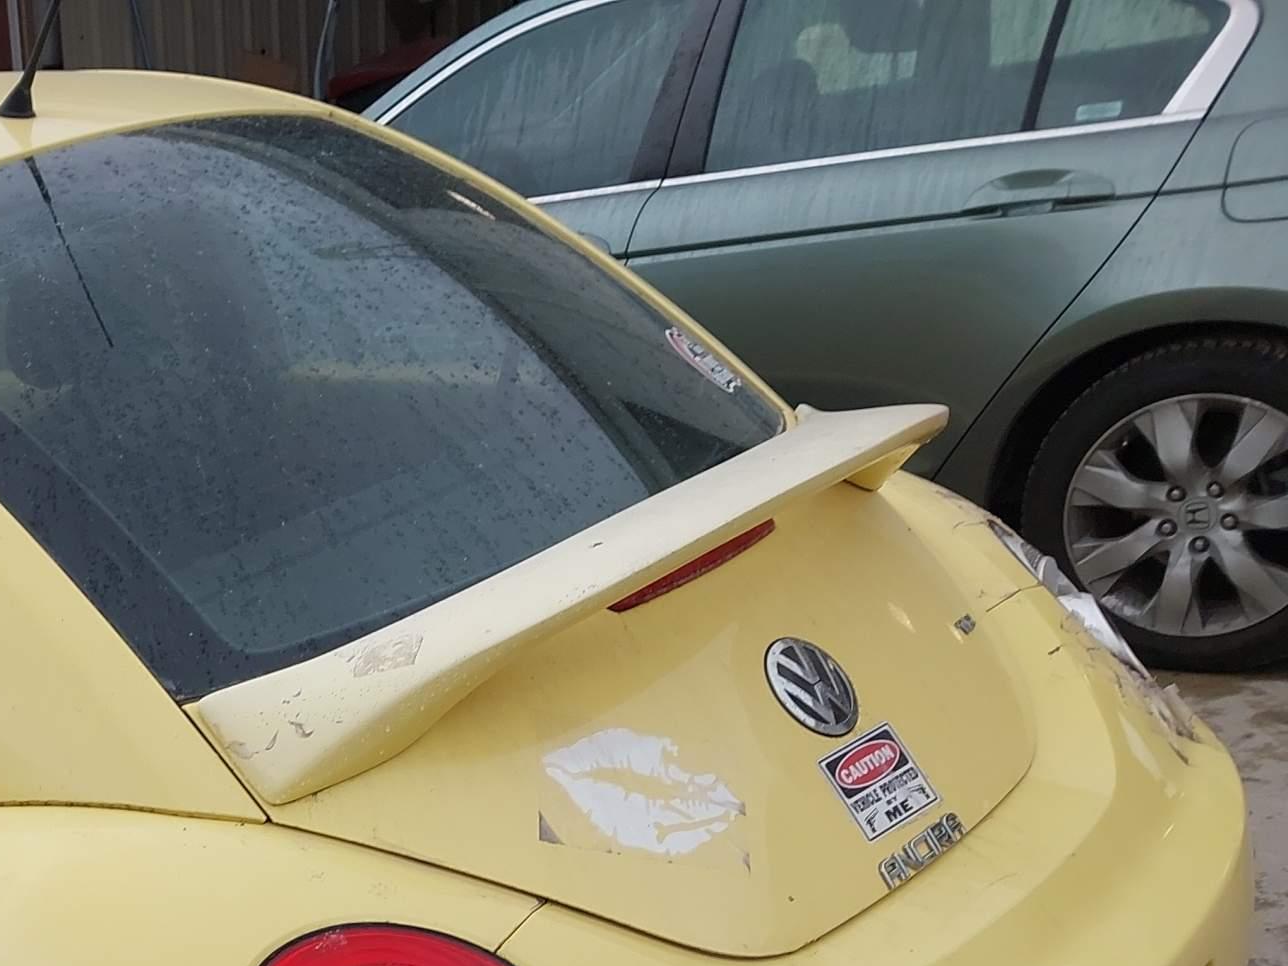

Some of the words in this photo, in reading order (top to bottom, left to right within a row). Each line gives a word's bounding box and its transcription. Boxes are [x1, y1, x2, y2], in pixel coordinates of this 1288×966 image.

[768, 640, 856, 732] VW
[840, 744, 895, 784] CAUTION
[885, 799, 913, 822] ME
